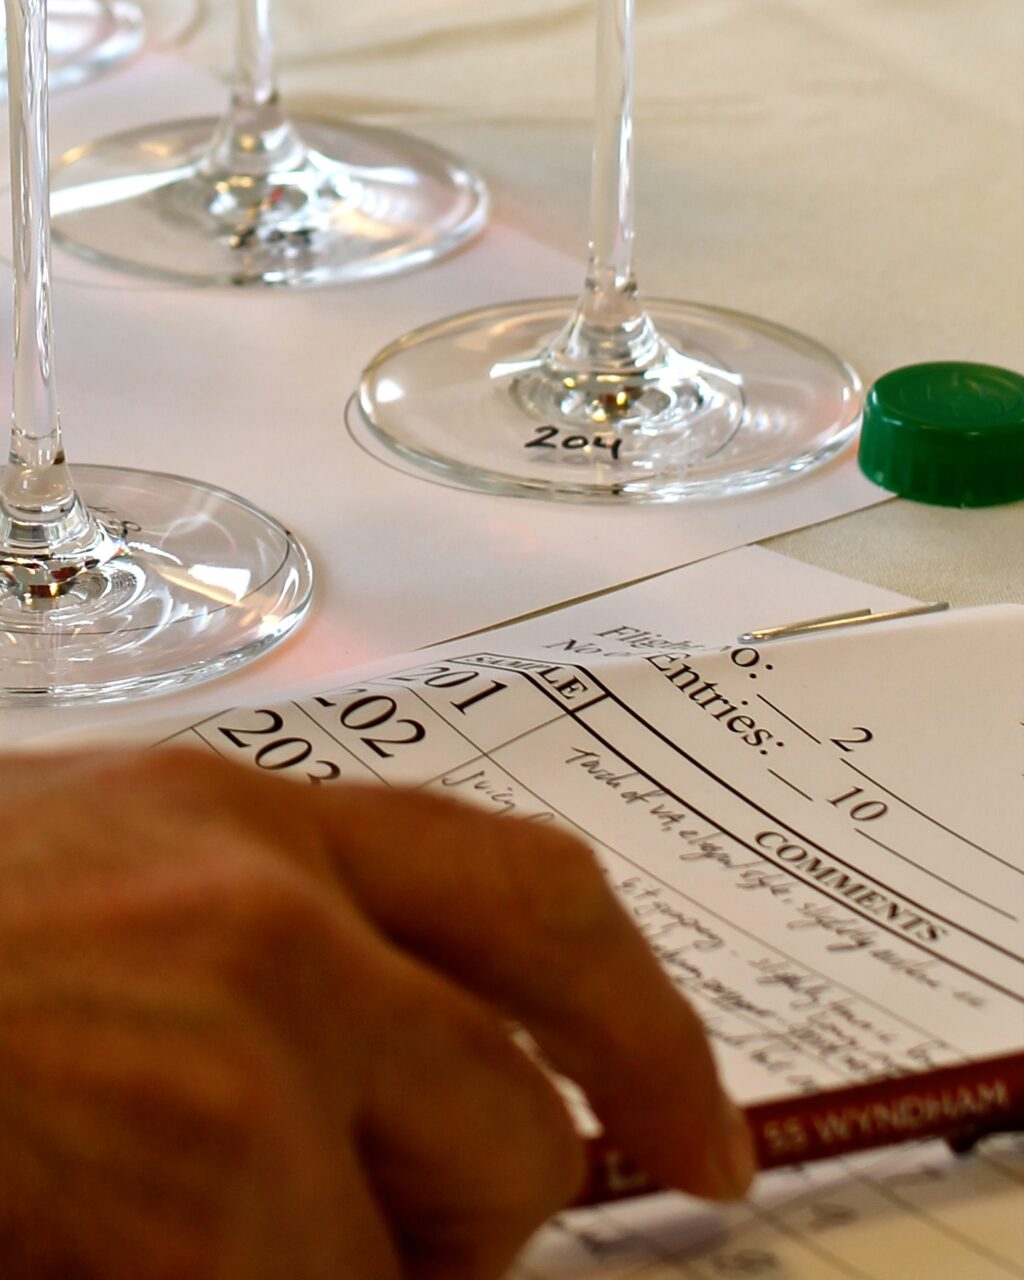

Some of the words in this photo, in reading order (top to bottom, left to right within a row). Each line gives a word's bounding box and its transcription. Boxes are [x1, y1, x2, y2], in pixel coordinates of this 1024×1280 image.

[524, 425, 622, 460] 204
[643, 651, 785, 756] Entries:
[826, 786, 889, 822] 10
[830, 726, 874, 753] 2
[755, 830, 949, 943] COMMENTS
[813, 1078, 1011, 1144] WYNDHAM
